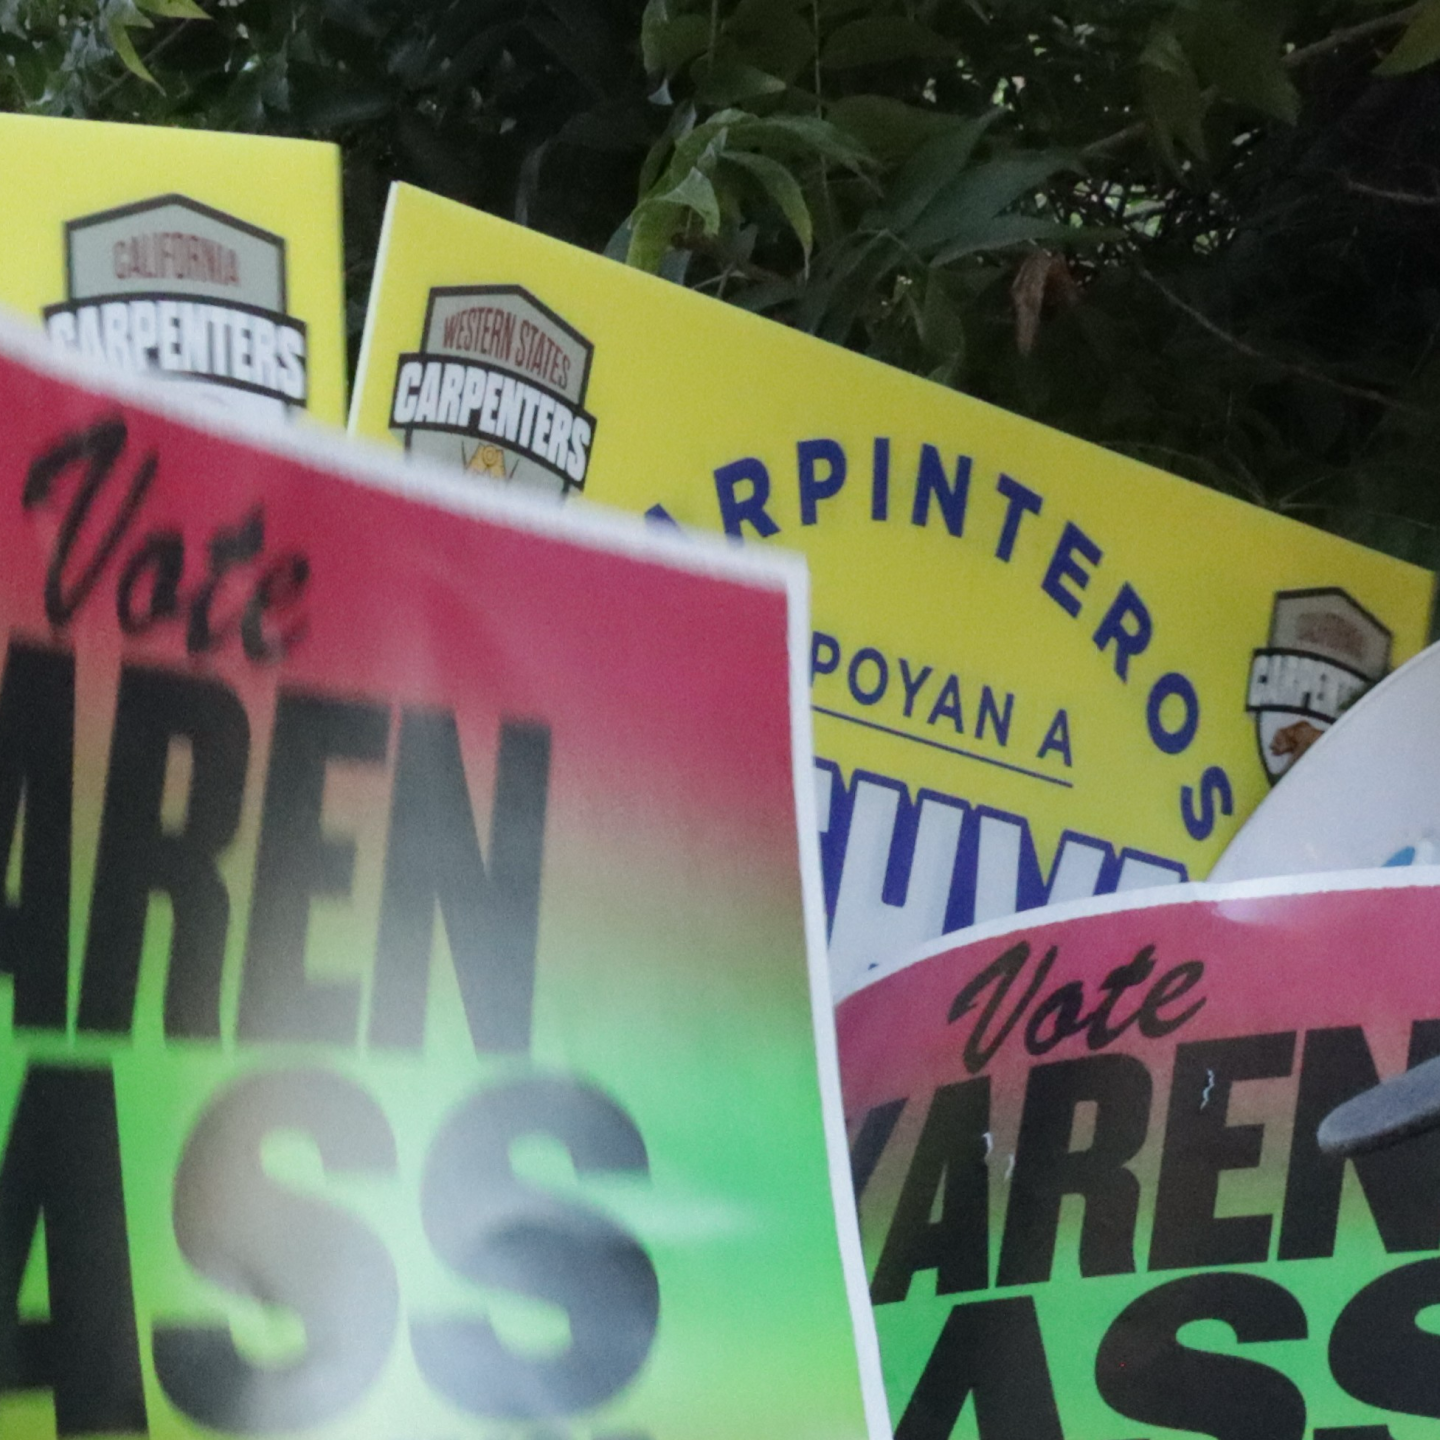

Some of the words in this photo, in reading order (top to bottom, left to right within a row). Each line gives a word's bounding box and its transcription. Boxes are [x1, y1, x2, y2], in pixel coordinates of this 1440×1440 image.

[442, 307, 517, 363] WESTERN
[515, 319, 572, 391] STATES
[393, 361, 592, 482] CARPENTERS
[21, 408, 312, 666] Vote
[1036, 708, 1074, 768] A
[948, 940, 1207, 1074] Vote
